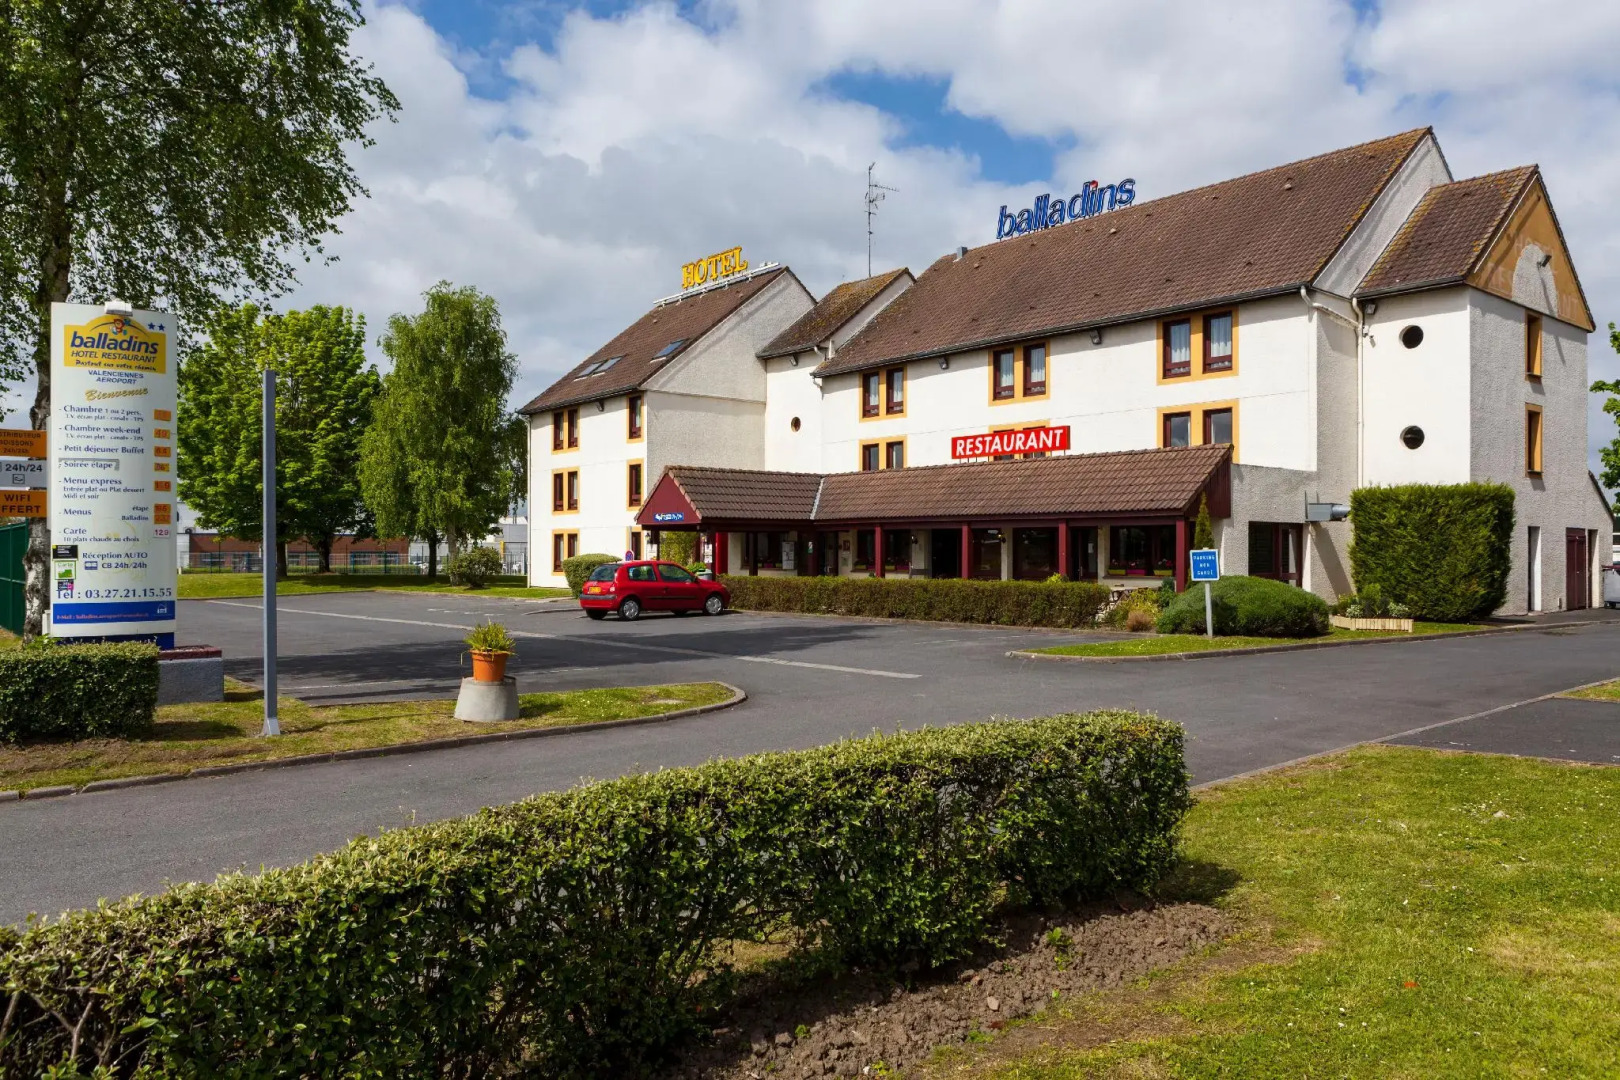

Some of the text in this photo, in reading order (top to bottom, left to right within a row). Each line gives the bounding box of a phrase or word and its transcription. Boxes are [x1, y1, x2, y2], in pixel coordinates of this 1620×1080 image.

[996, 178, 1136, 239] balladins
[682, 245, 748, 288] HOTEL
[70, 330, 159, 354] balladins
[102, 352, 157, 363] RESTAURANT
[88, 370, 144, 378] VALENCIENNES
[85, 388, 148, 402] Bienvenue
[64, 404, 102, 413] Chambre
[103, 426, 140, 434] week-end
[956, 429, 1064, 456] RESTAURANT
[84, 445, 118, 453] déjeuner
[6, 464, 42, 472] 24h/24
[82, 552, 122, 560] Réception
[85, 588, 172, 599] 03.27.21.15.55
